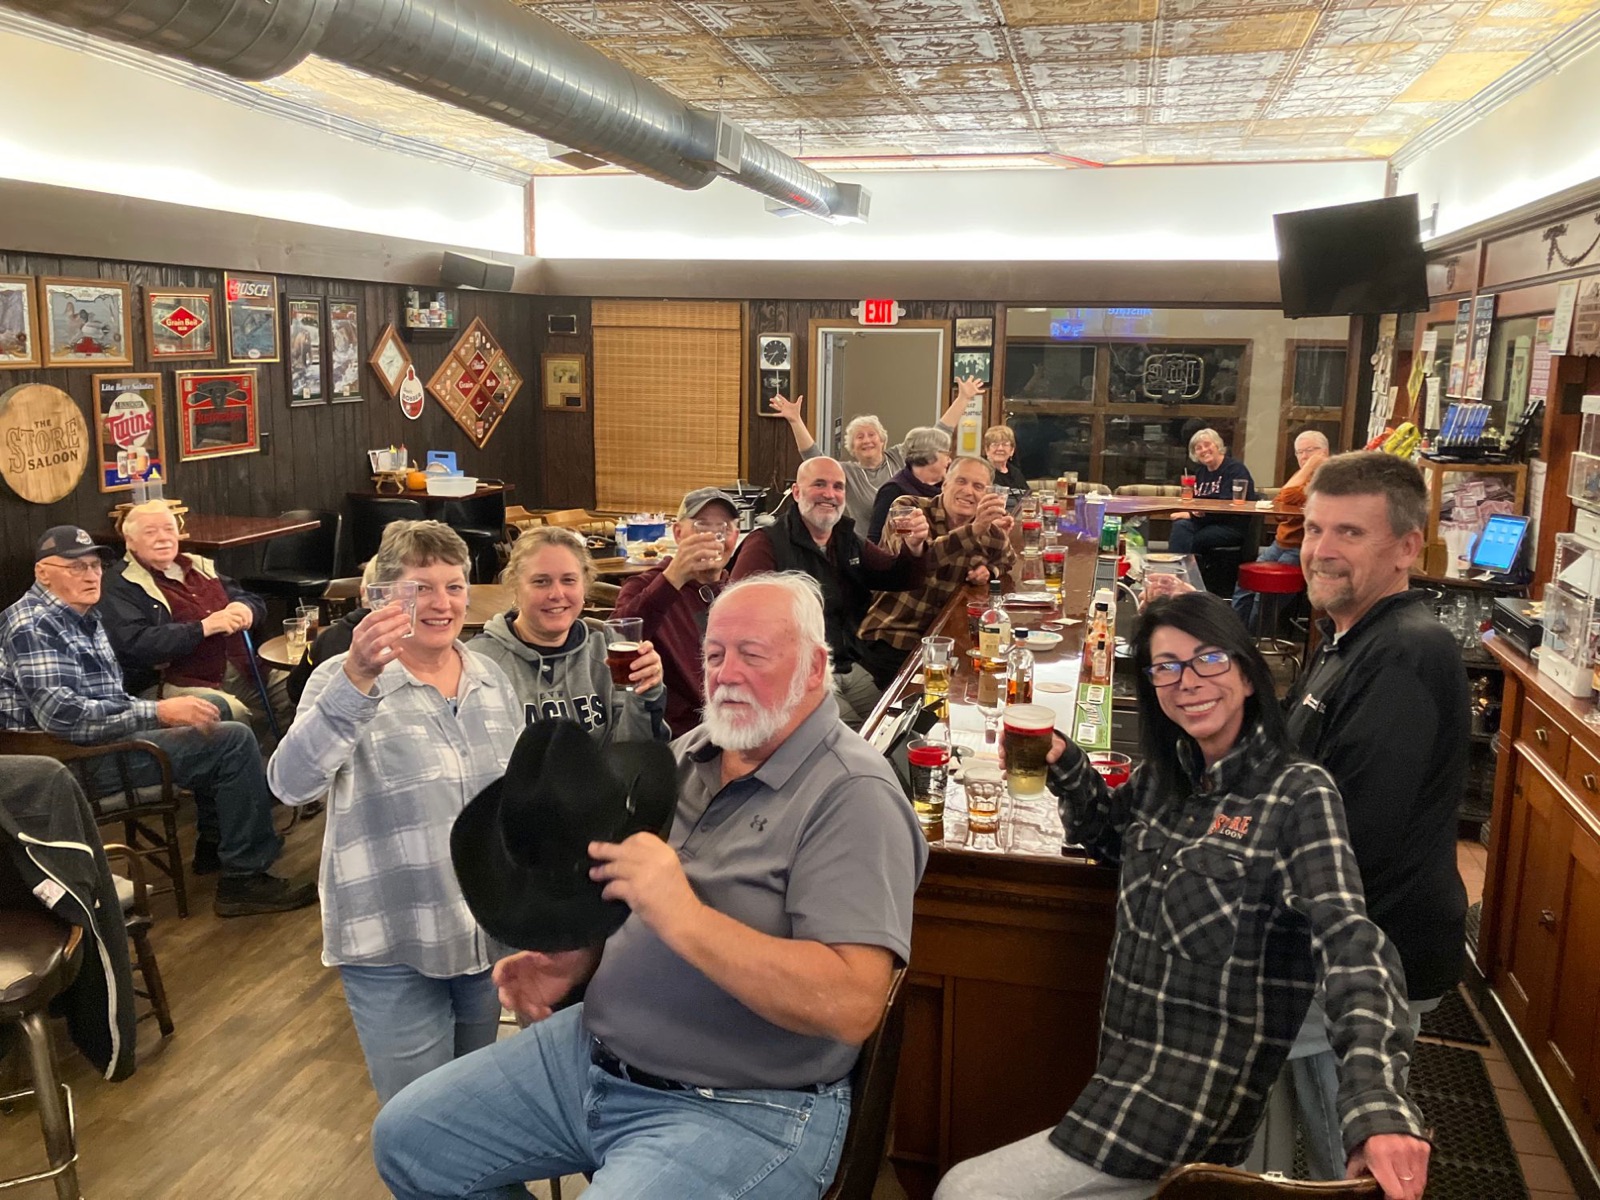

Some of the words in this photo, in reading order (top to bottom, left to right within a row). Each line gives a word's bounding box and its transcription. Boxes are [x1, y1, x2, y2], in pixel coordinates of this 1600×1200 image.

[231, 282, 270, 297] BUSCH
[865, 299, 894, 323] EXIT
[165, 318, 184, 327] Grain
[34, 419, 52, 429] THE
[105, 410, 154, 446] Twins
[6, 418, 80, 473] STORE
[27, 450, 79, 471] SALOON
